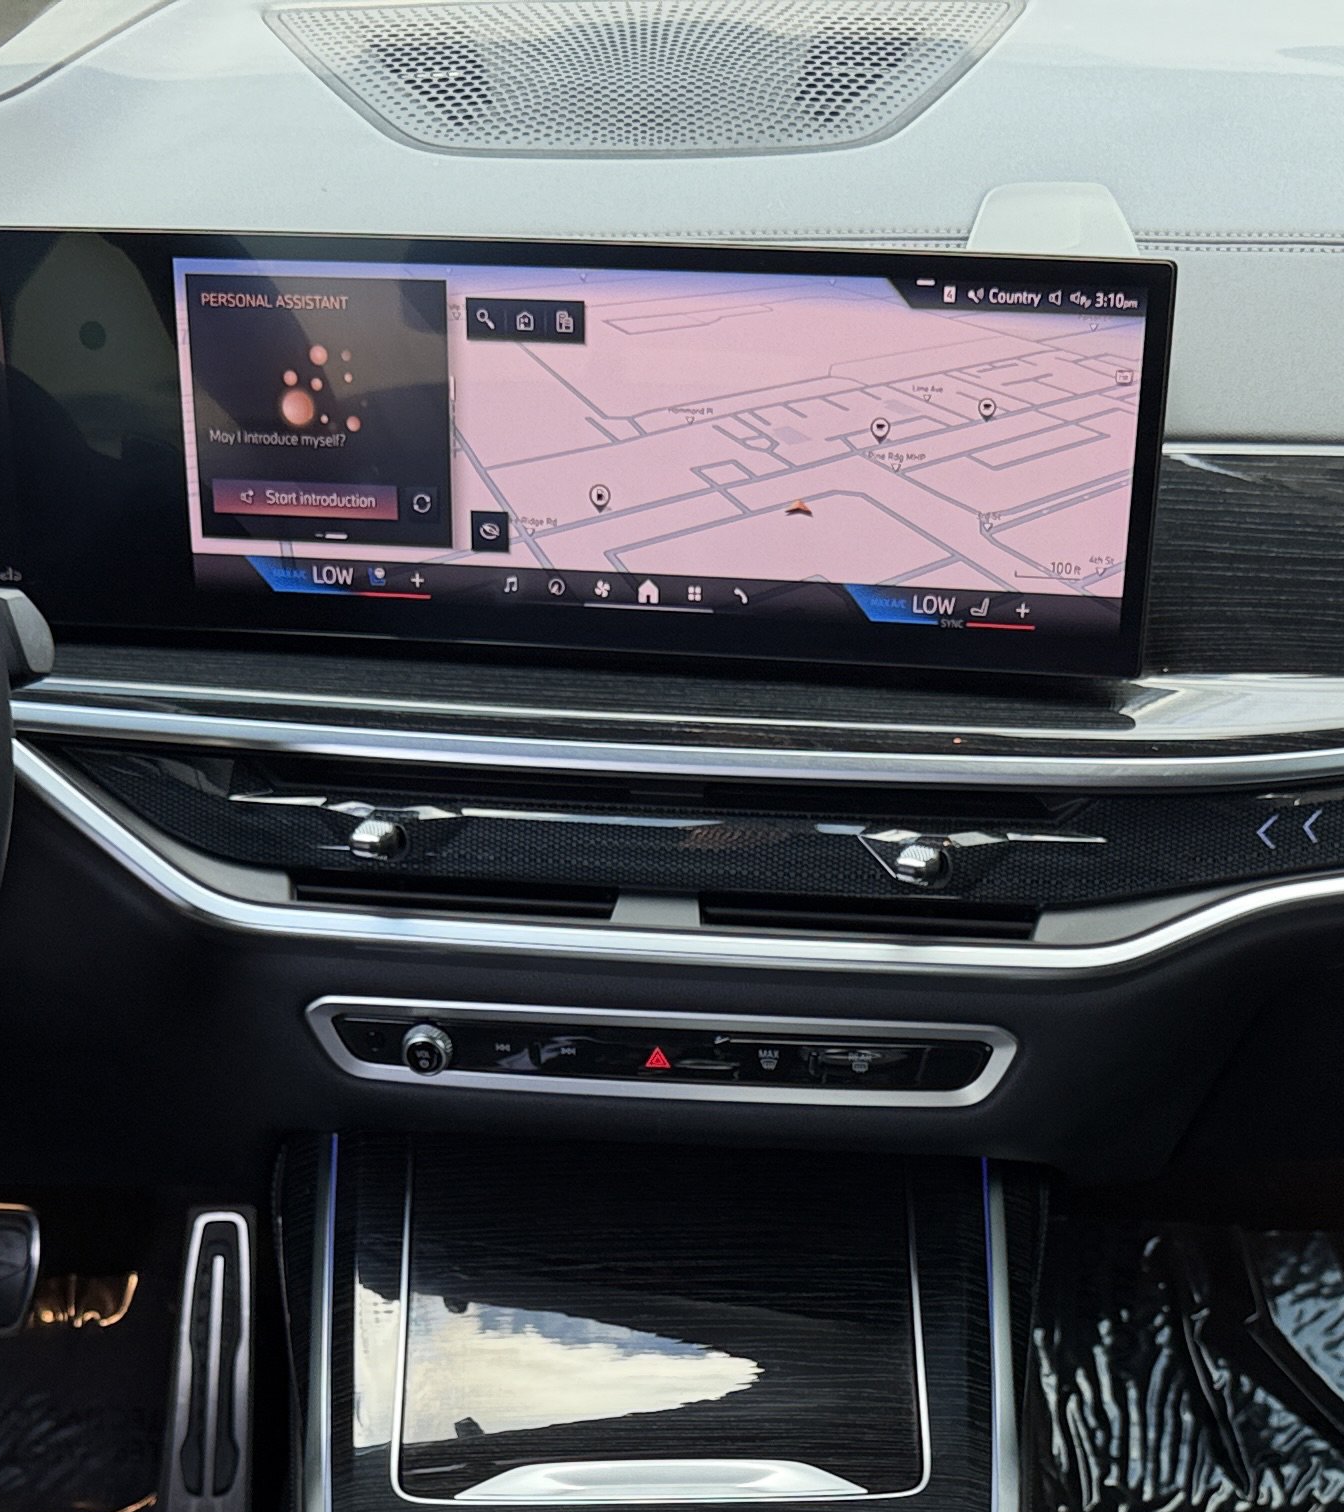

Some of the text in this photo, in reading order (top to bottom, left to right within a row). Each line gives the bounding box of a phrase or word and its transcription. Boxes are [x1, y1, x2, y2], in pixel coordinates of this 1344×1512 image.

[200, 293, 349, 311] PERSONAL ASSISTANT
[989, 287, 1041, 307] Country
[210, 430, 234, 445] May
[244, 431, 298, 446] introduce
[301, 433, 346, 449] myself?
[265, 490, 376, 508] Start introduction
[312, 565, 354, 585] LOW
[1050, 561, 1073, 575] 100
[912, 594, 956, 615] LOW
[758, 1049, 780, 1058] MAX
